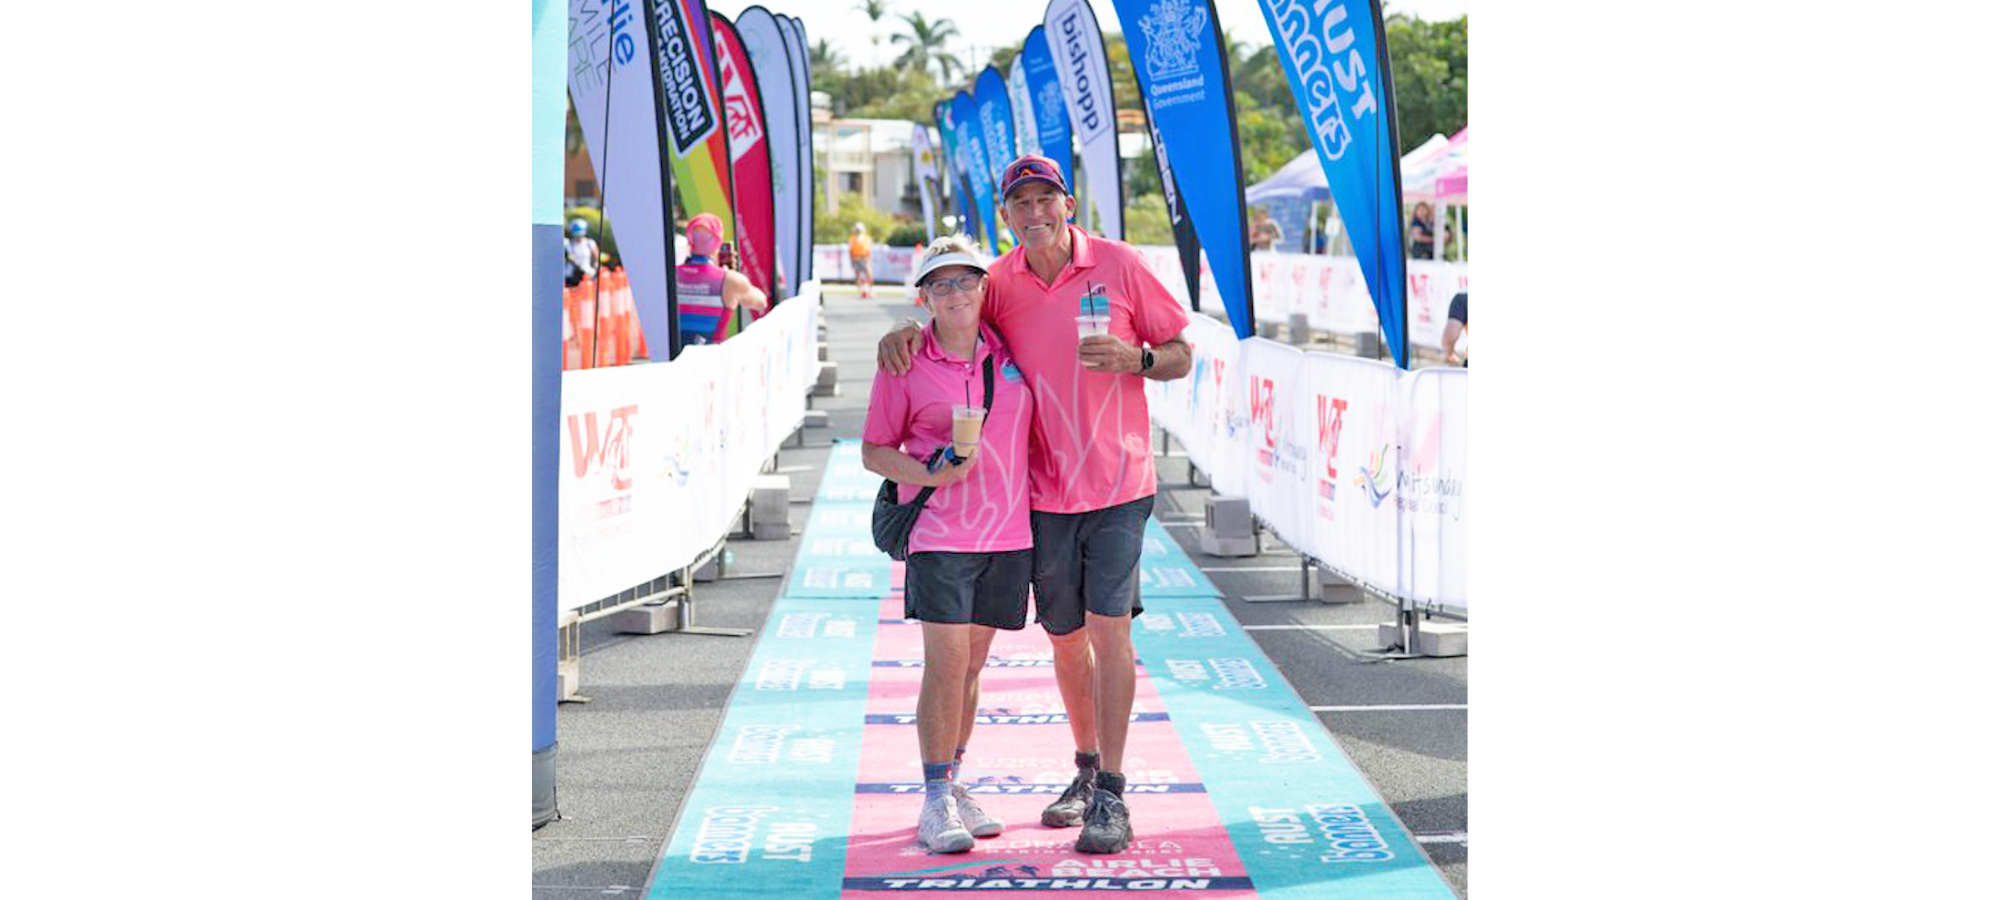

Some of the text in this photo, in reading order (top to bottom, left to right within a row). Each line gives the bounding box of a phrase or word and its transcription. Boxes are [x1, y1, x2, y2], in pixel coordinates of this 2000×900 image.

[568, 17, 597, 98] ARE
[580, 0, 617, 85] MILE
[603, 0, 634, 65] lie
[1314, 0, 1377, 119] UST
[655, 0, 706, 133] RECISION
[1062, 14, 1100, 132] bishopp
[1150, 73, 1204, 97] Queensland
[1153, 89, 1205, 109] Government
[1269, 0, 1352, 161] nners
[1053, 858, 1215, 868] AIRLIE
[1304, 803, 1395, 863] banners
[884, 879, 1211, 889] TRIATHLON
[1051, 867, 1222, 877] BEACH
